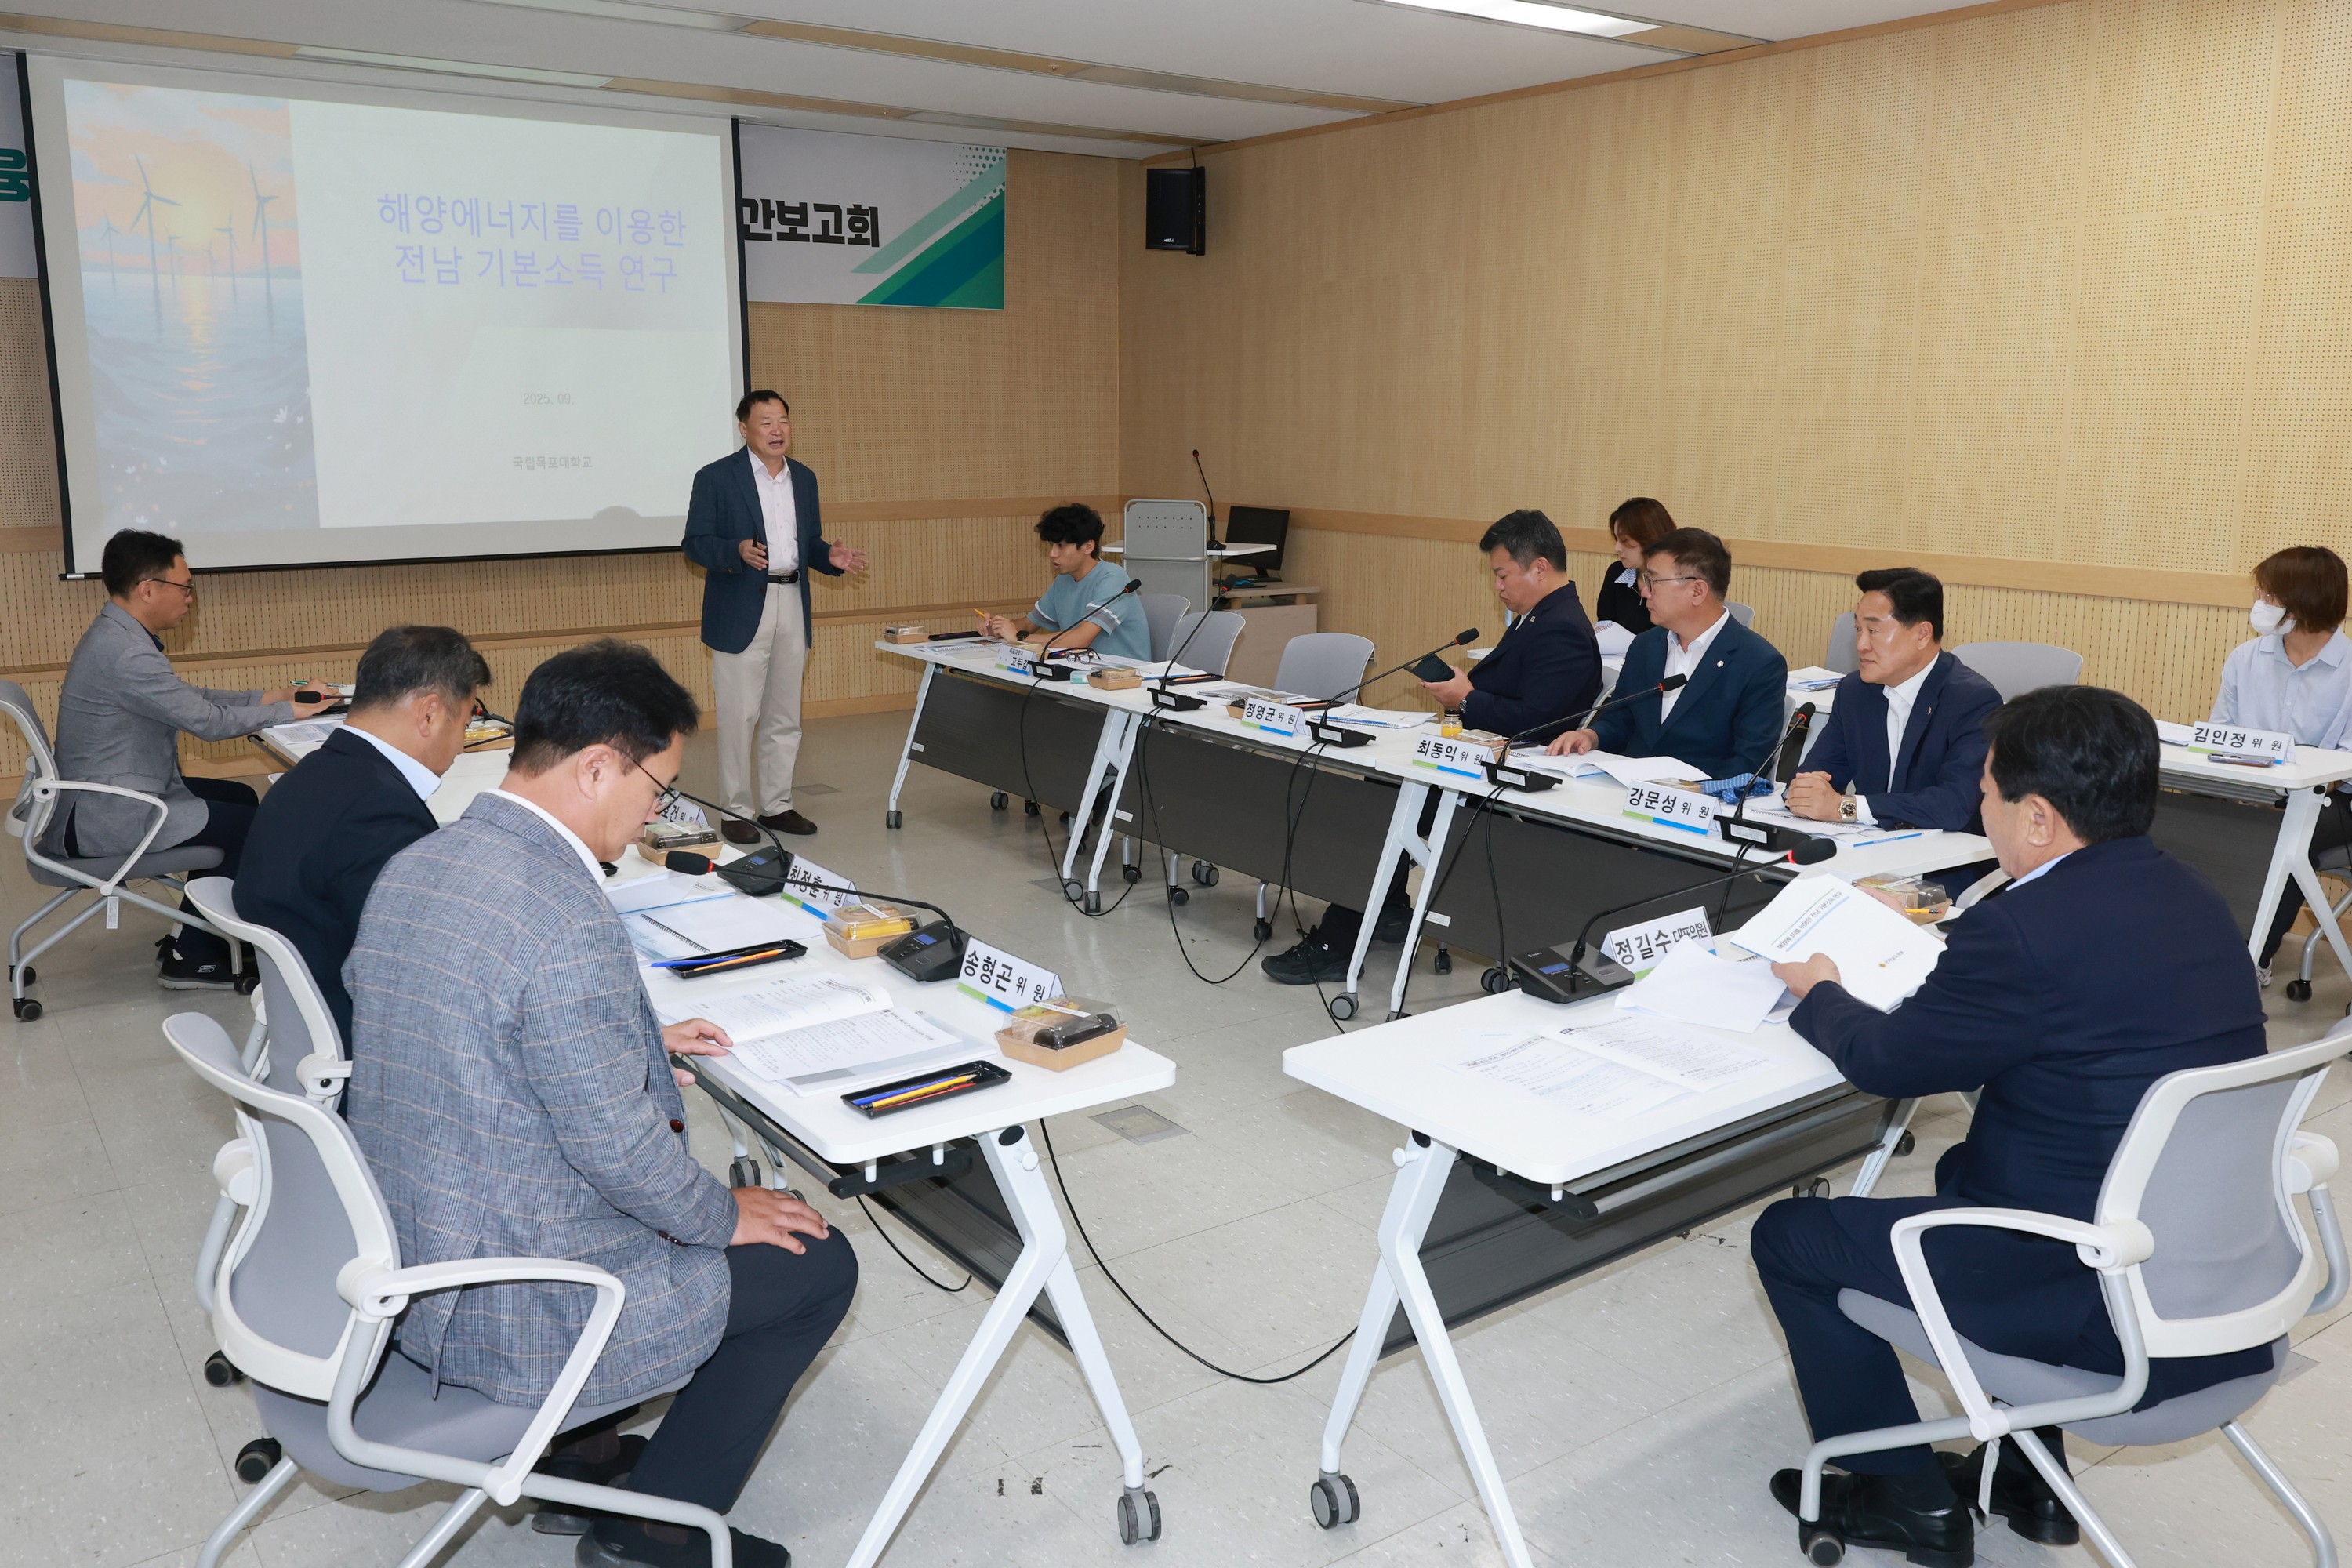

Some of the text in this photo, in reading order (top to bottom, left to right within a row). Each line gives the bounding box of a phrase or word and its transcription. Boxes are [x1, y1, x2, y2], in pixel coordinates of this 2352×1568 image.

[377, 194, 687, 246] 해양에너지를 이용한
[742, 198, 880, 248] 간보고회
[395, 244, 677, 293] 전남 기본소득 연구
[523, 393, 575, 405] 2025. 09.
[512, 456, 593, 470] 국립목포대학교
[1245, 702, 1276, 722] 정영균
[1417, 739, 1457, 762] 최동익
[2194, 727, 2247, 748] 김인정
[1628, 787, 1678, 814] 강문성
[1614, 929, 1671, 965] 정길수
[964, 949, 1014, 993] 송형곤
